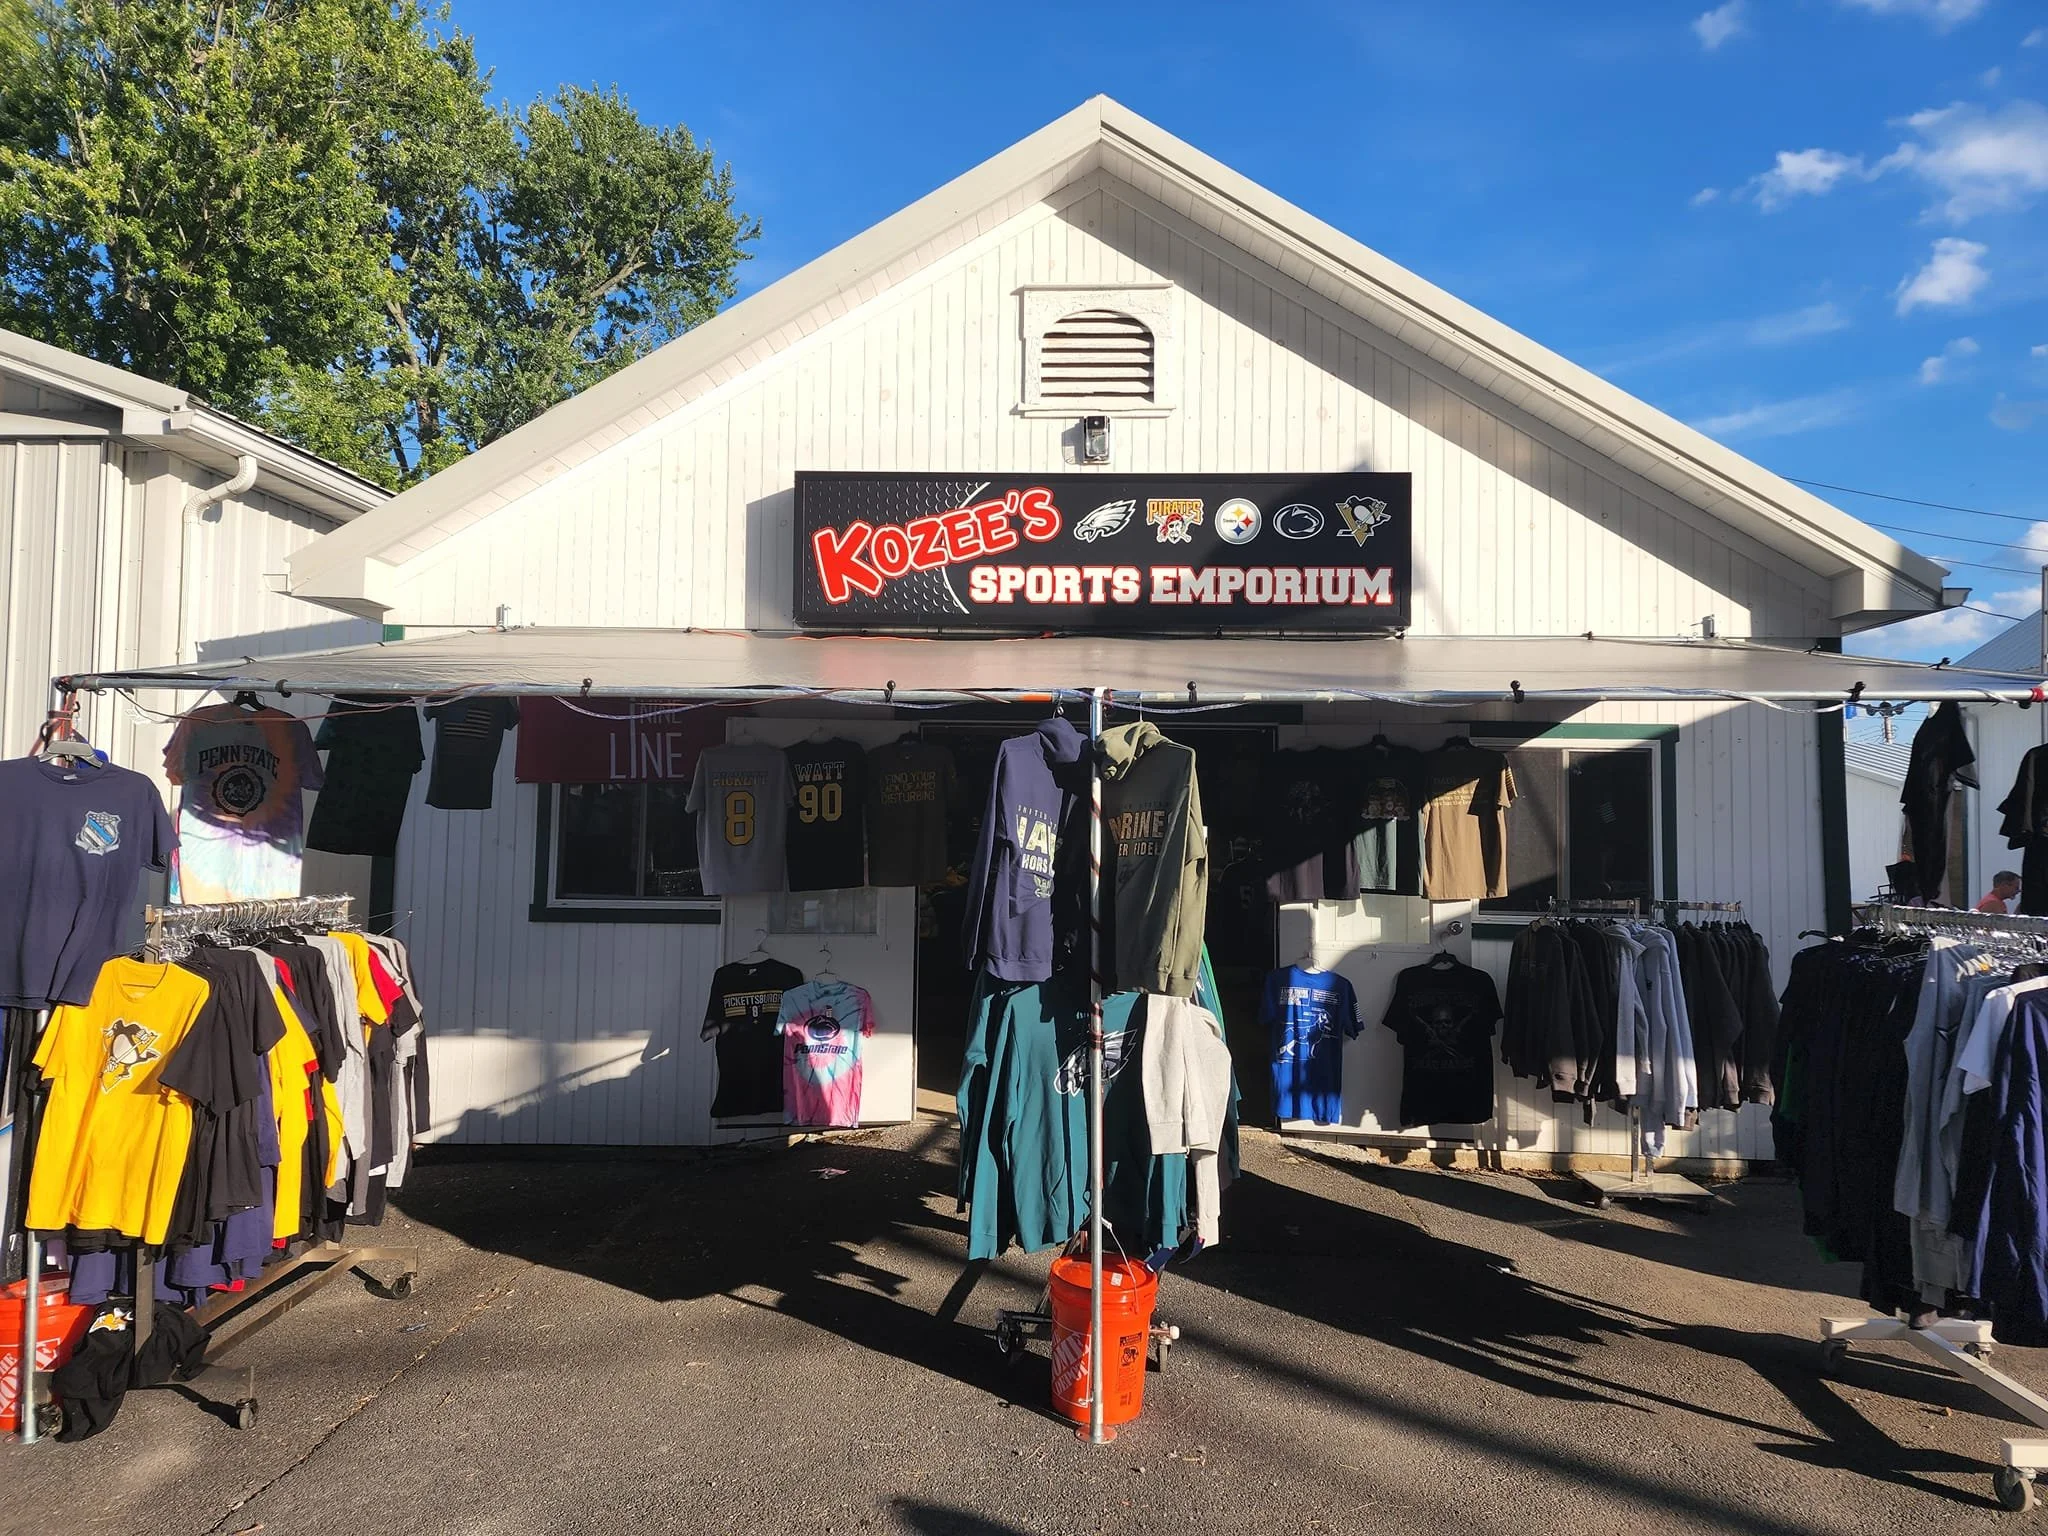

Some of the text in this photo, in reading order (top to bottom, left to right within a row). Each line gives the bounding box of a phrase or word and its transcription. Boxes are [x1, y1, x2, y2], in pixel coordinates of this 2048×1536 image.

[1147, 498, 1203, 523] PIRATES
[811, 486, 1062, 603] KOZEE'S
[967, 564, 1394, 605] SPORTS EMPORIUM
[198, 745, 281, 780] PENN STATE
[609, 731, 685, 780] LINE
[795, 761, 845, 782] WATT
[724, 790, 756, 847] 8
[799, 782, 843, 824] 90
[751, 1005, 760, 1018] 8
